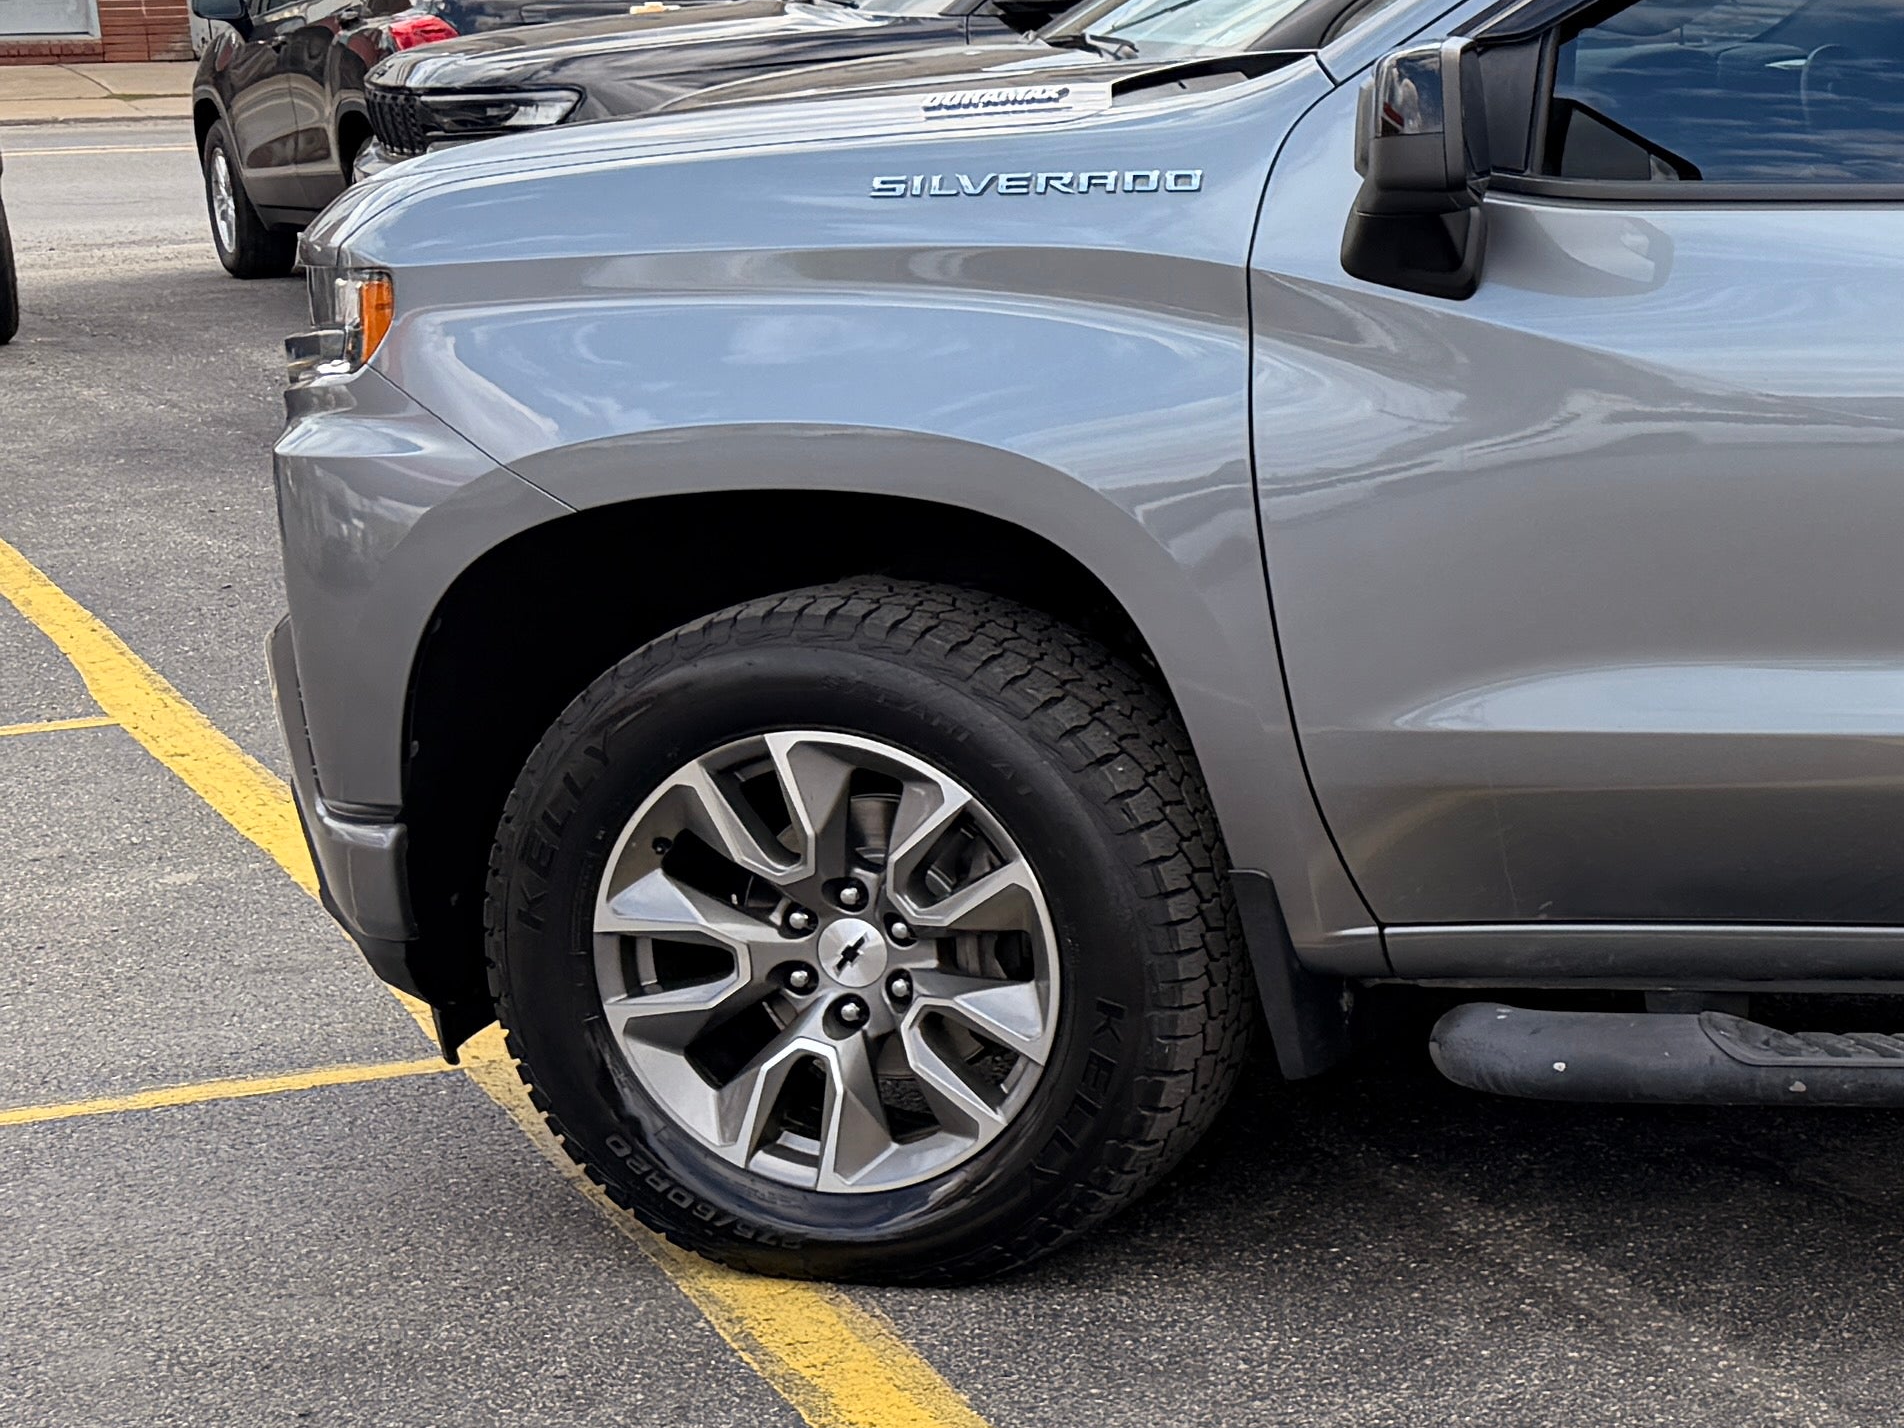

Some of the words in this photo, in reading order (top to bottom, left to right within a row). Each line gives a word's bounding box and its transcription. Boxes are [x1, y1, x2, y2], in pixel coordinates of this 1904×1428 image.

[922, 86, 1070, 112] DURAMAX
[869, 168, 1204, 199] SILVERADO
[515, 726, 612, 934] KELLY
[1027, 997, 1128, 1195] KELLY
